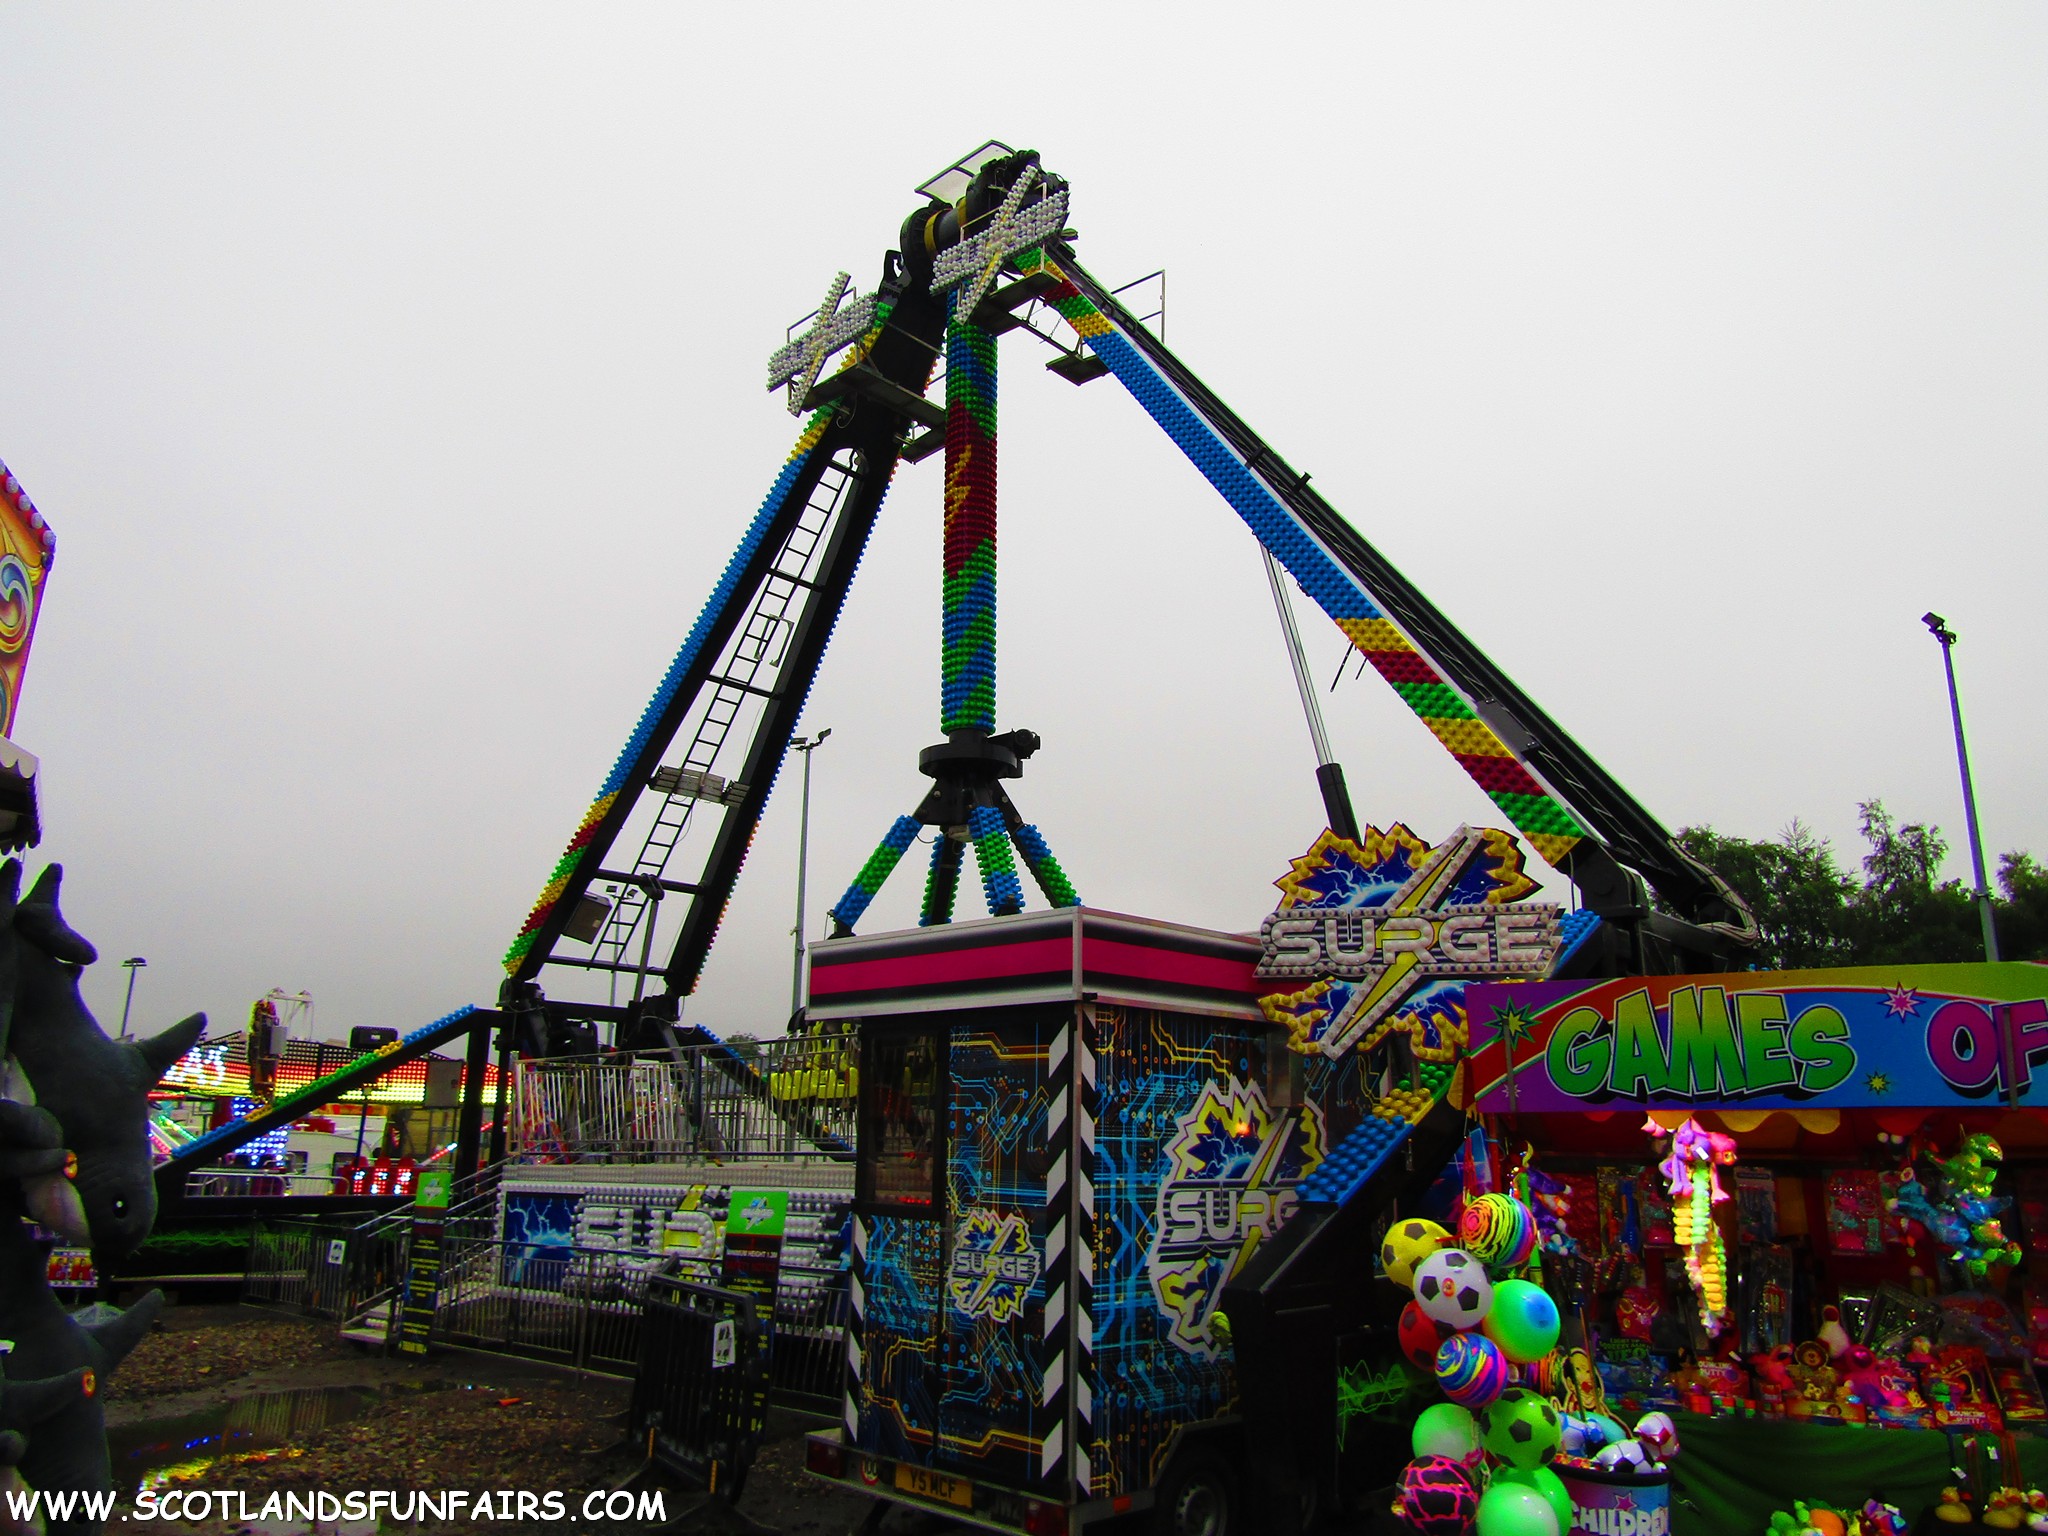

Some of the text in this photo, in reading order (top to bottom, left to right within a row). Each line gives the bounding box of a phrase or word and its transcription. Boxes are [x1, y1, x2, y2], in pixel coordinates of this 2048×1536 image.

[1270, 913, 1540, 966] SURGE
[1544, 983, 1858, 1097] GAMES
[577, 1205, 820, 1287] SURE
[956, 1251, 1035, 1281] SURGE
